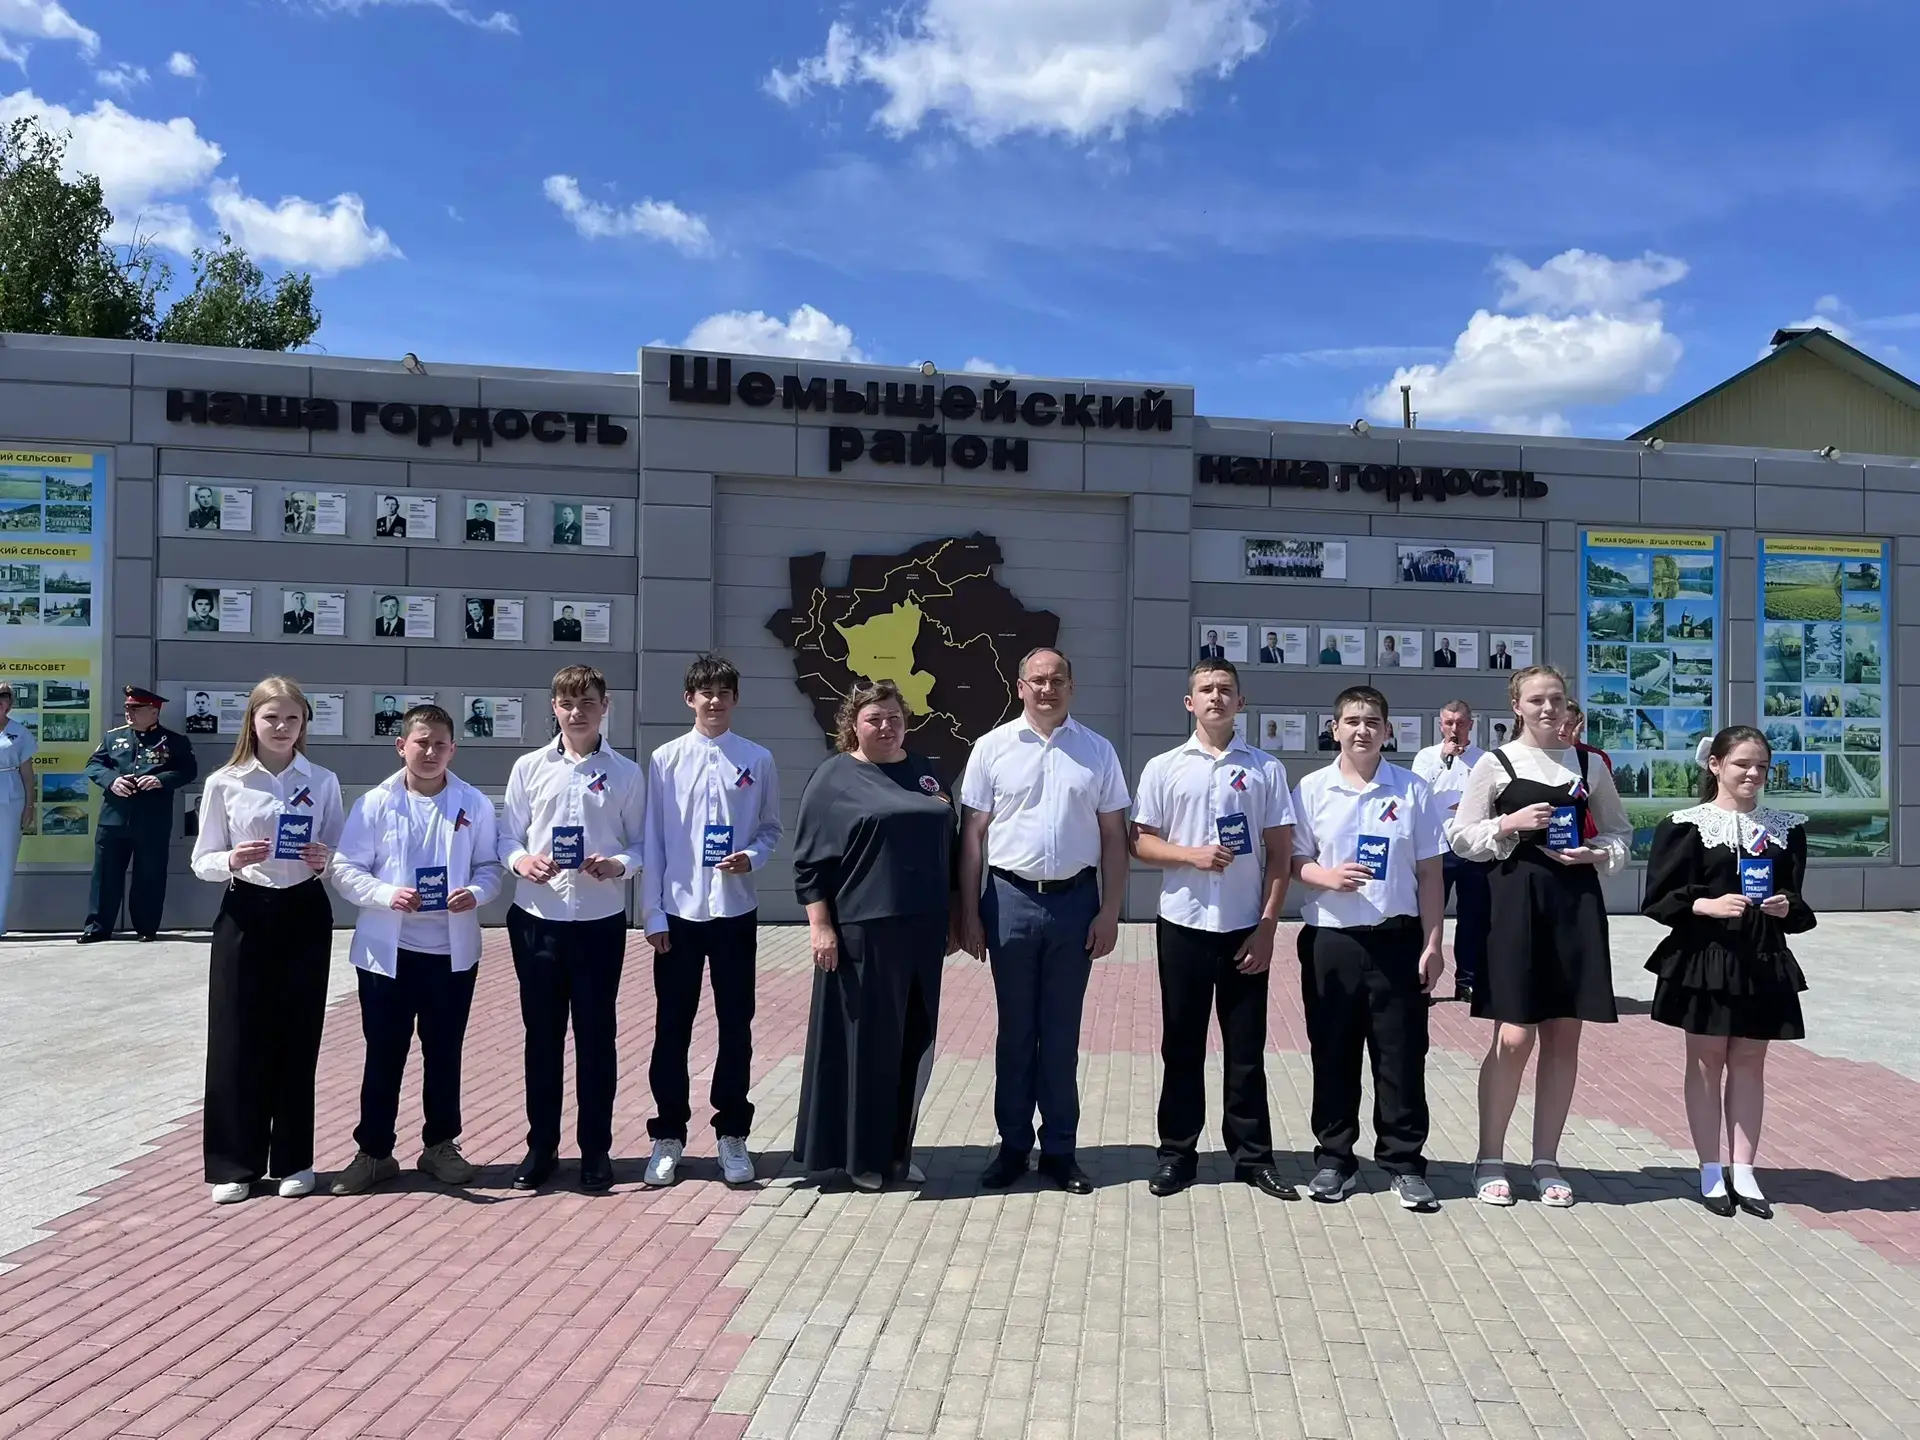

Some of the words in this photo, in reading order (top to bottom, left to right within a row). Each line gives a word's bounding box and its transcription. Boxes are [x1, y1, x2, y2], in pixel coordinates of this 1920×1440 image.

[669, 354, 1173, 431] Шемышейский
[166, 389, 340, 431] наша
[351, 401, 628, 447] гордость
[16, 454, 72, 463] СЕЛЬСОВЕТ
[828, 423, 1029, 472] район
[1200, 455, 1329, 489] наша
[1337, 464, 1549, 502] гордость
[20, 548, 78, 556] СЕЛЬСОВЕТ
